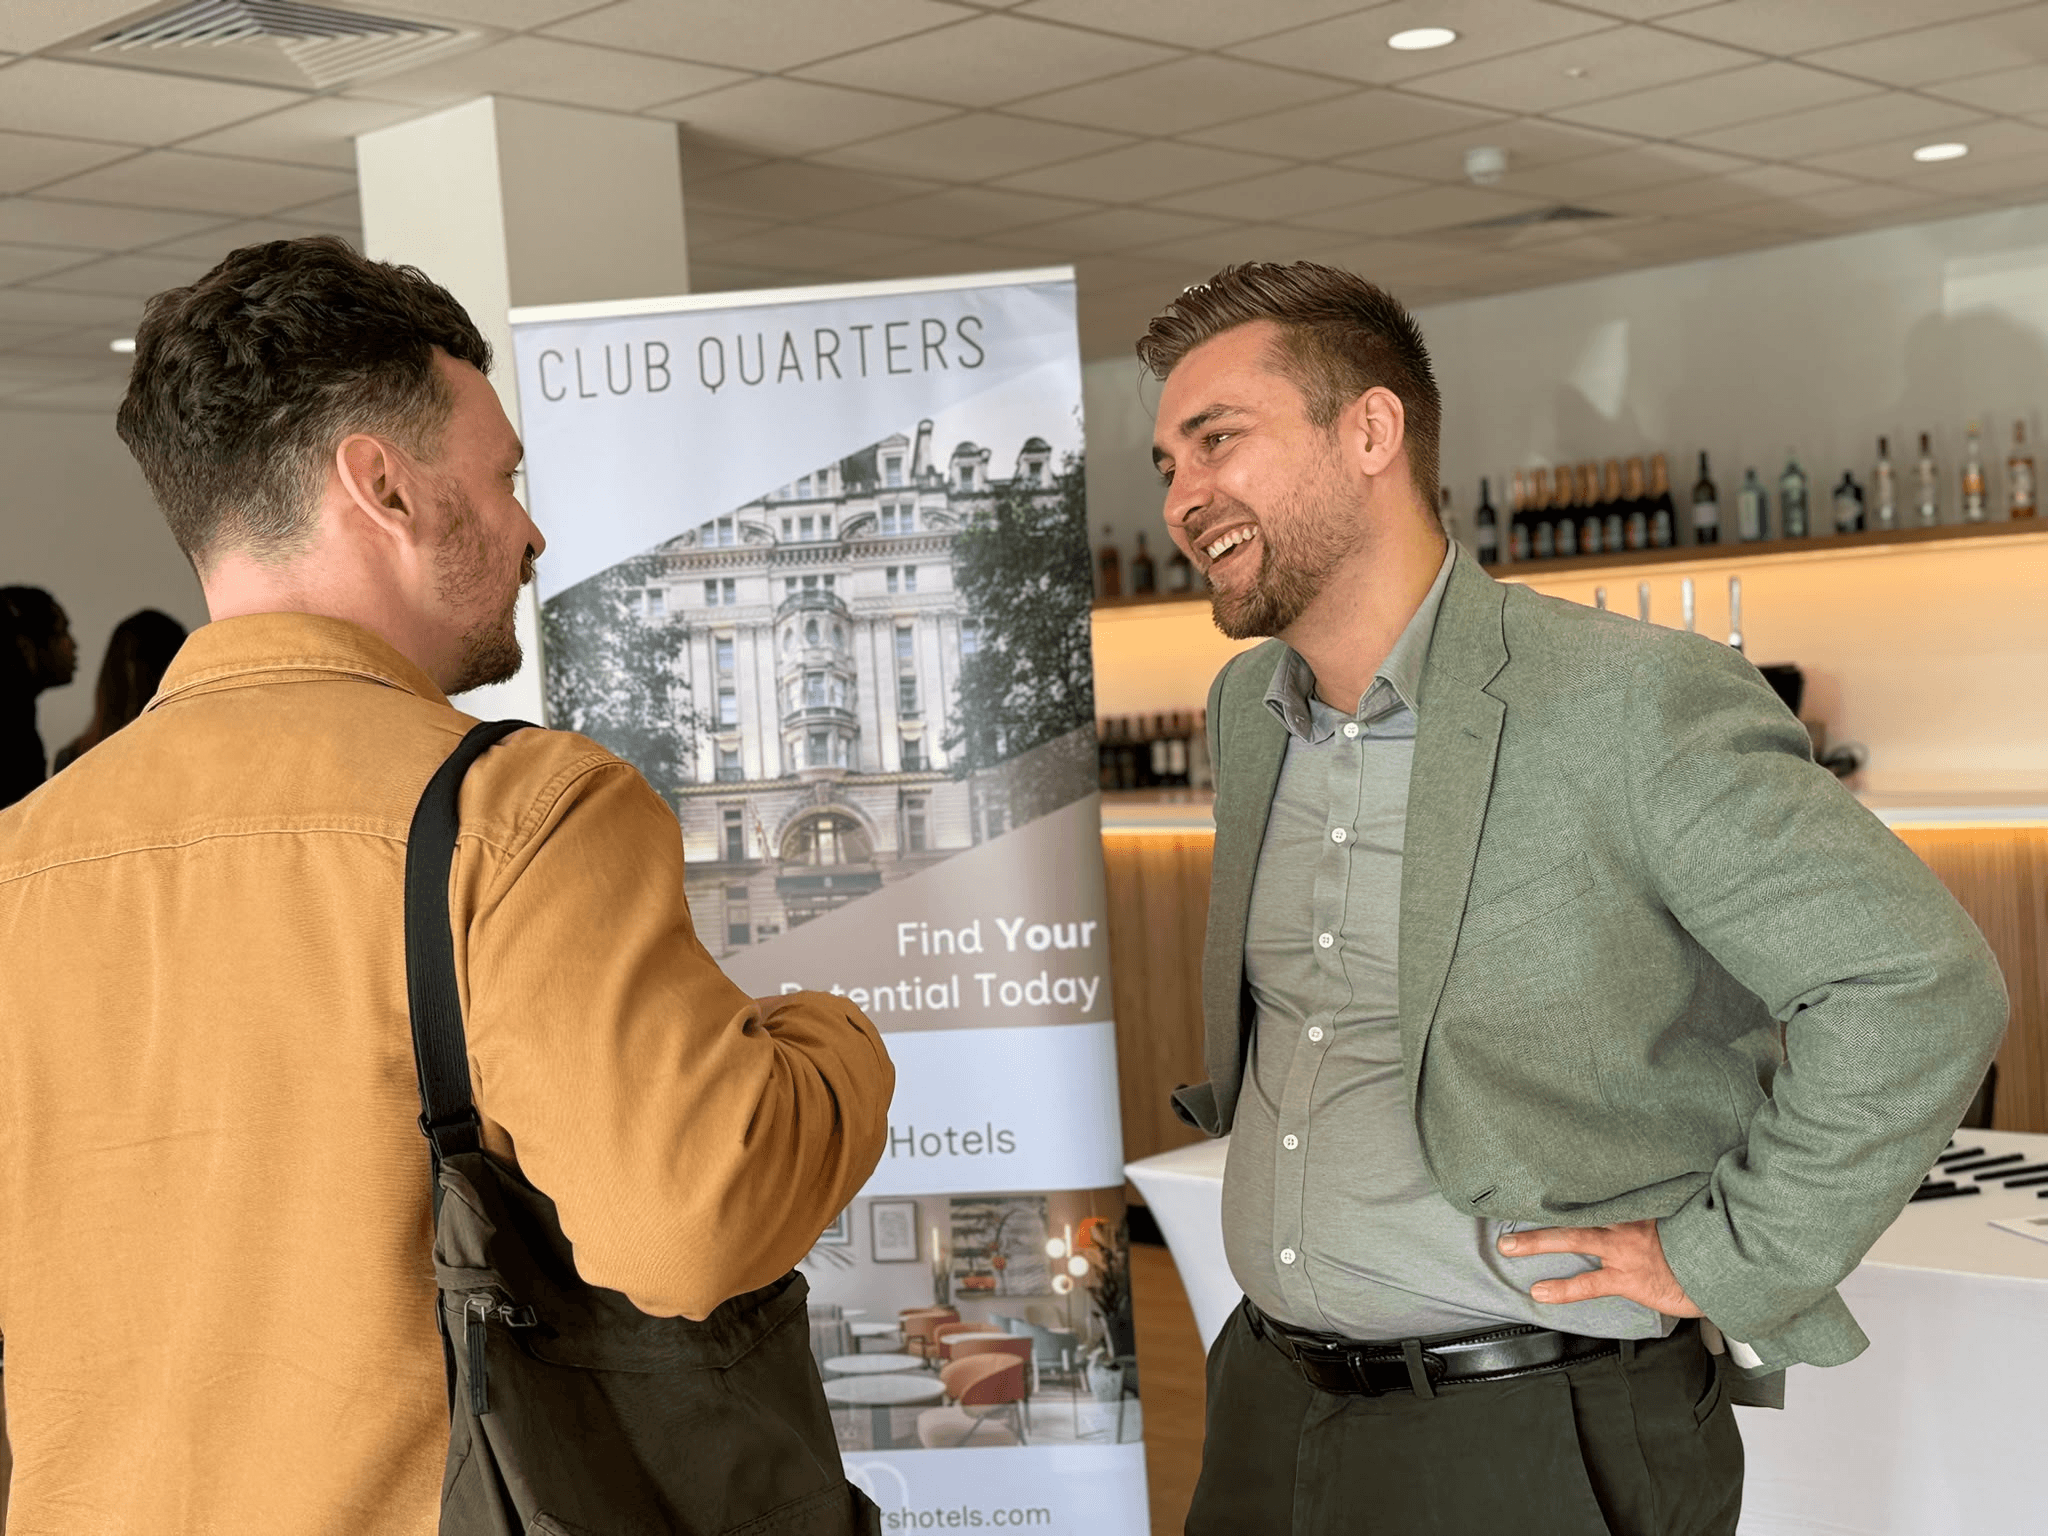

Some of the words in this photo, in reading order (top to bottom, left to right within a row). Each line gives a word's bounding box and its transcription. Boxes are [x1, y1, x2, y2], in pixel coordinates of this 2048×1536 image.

[538, 340, 672, 402] CLUB
[698, 315, 985, 395] QUARTERS
[897, 918, 985, 957] Find
[995, 916, 1098, 952] Your
[780, 974, 960, 1012] ential
[973, 970, 1100, 1013] Today
[889, 1121, 1017, 1159] Hotels
